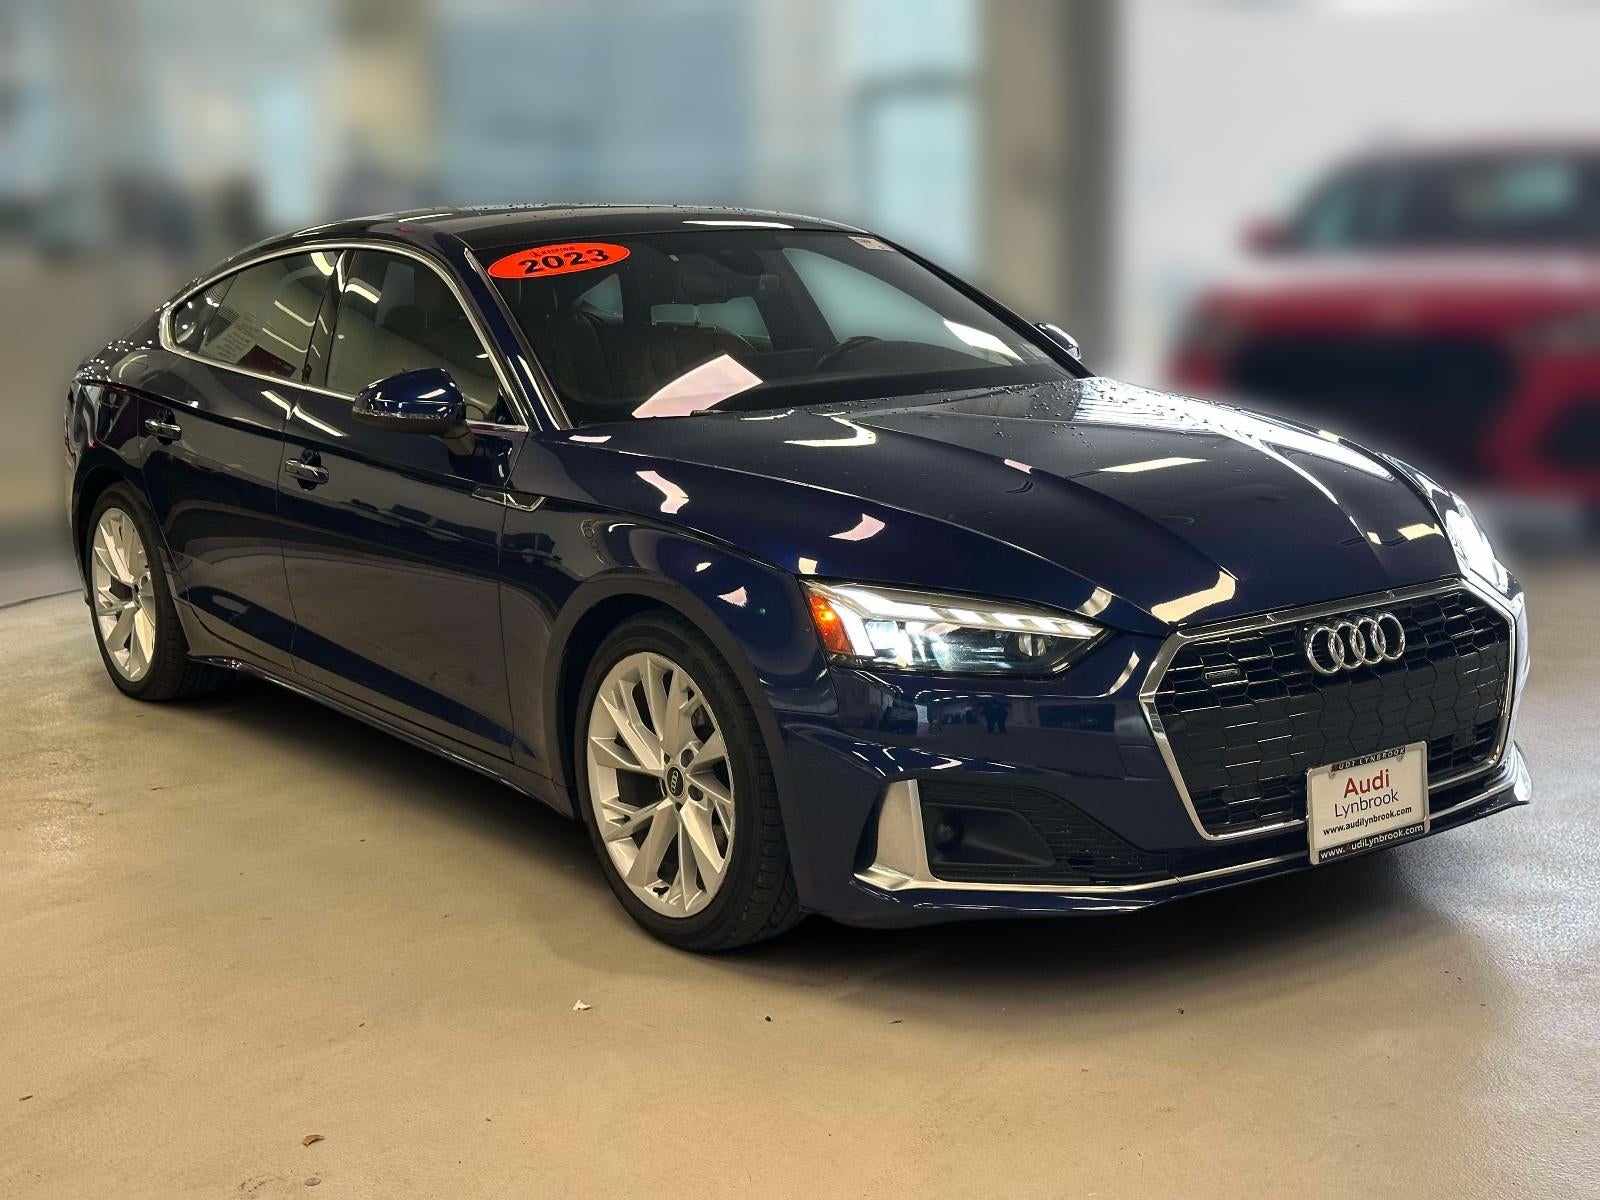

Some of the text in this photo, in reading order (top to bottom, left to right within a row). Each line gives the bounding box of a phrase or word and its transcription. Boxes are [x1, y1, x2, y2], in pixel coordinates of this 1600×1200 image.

[518, 248, 610, 274] 2023
[1359, 748, 1405, 765] LYNBROOK
[1343, 768, 1390, 798] Audi
[1334, 788, 1399, 819] Lynbrook
[1322, 806, 1412, 836] www.audilynbrook.com
[1319, 824, 1424, 860] www.AudiLynbrook.com
